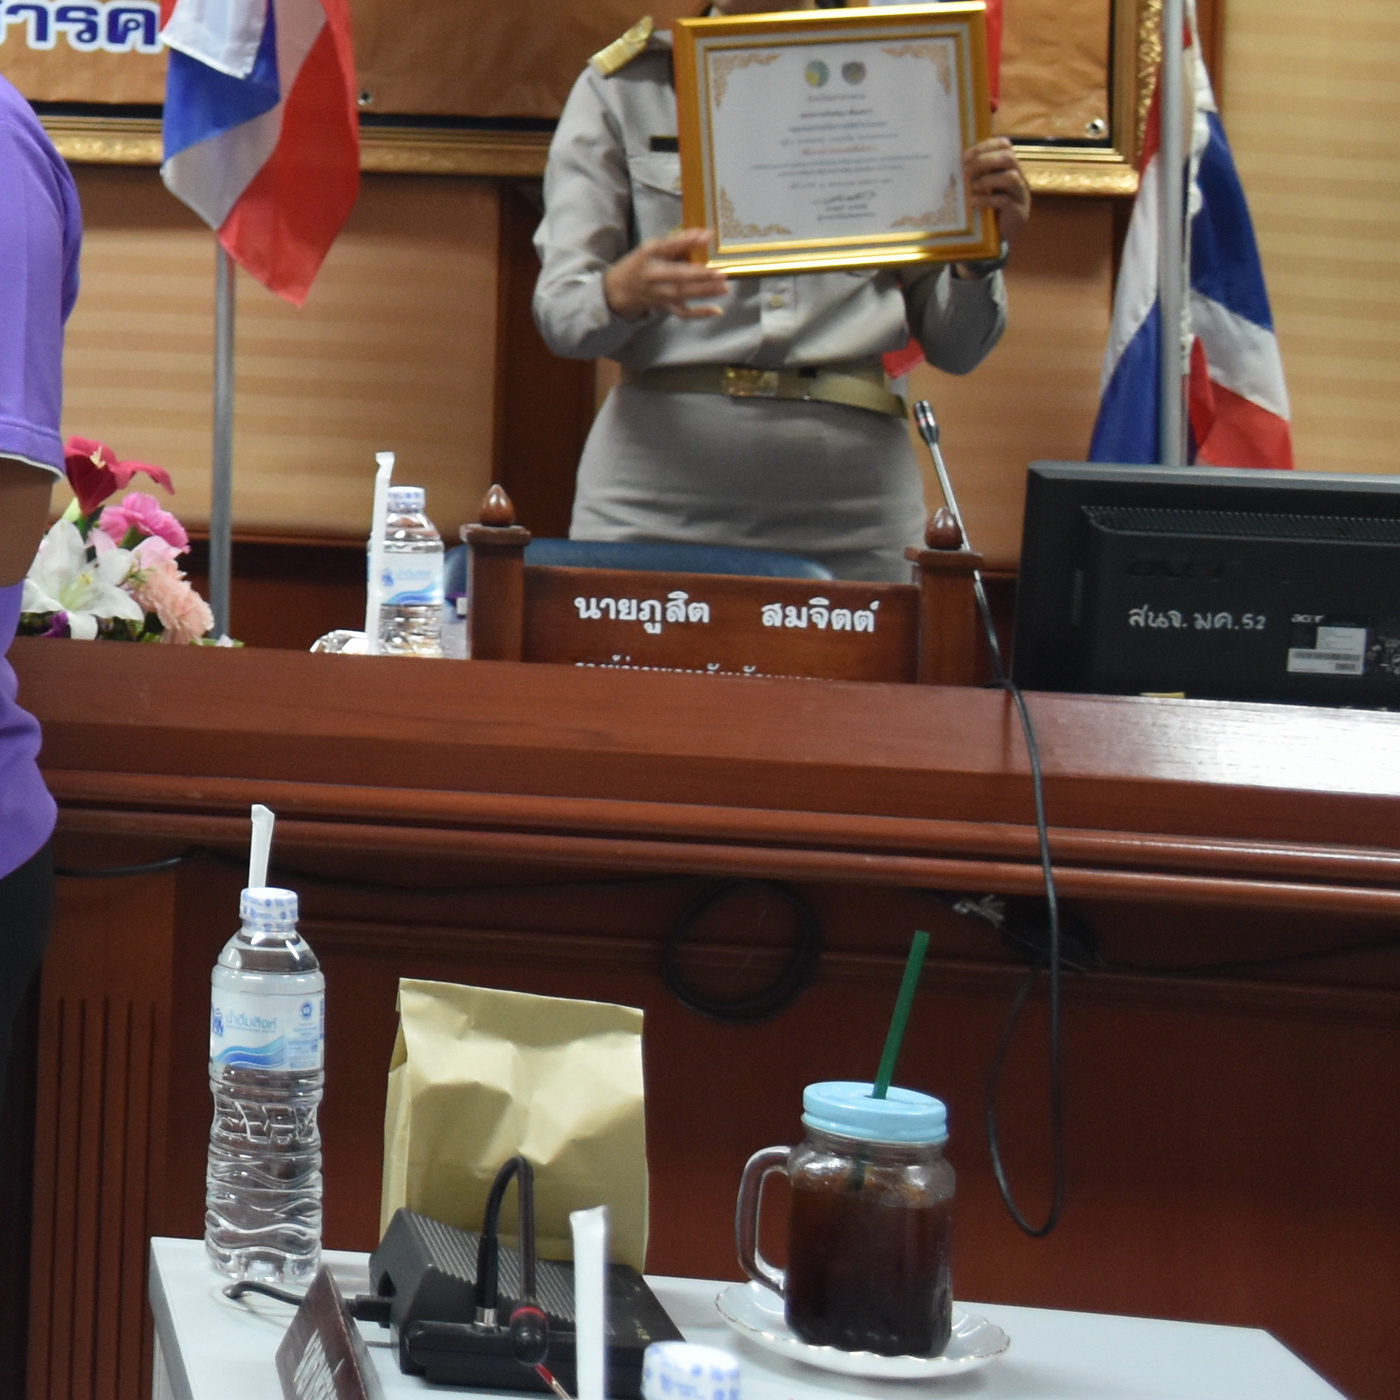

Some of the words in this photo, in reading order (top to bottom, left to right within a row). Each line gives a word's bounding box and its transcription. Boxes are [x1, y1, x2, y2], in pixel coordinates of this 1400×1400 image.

[573, 590, 710, 635] นายภูสิต
[760, 596, 880, 633] สมจิตต์
